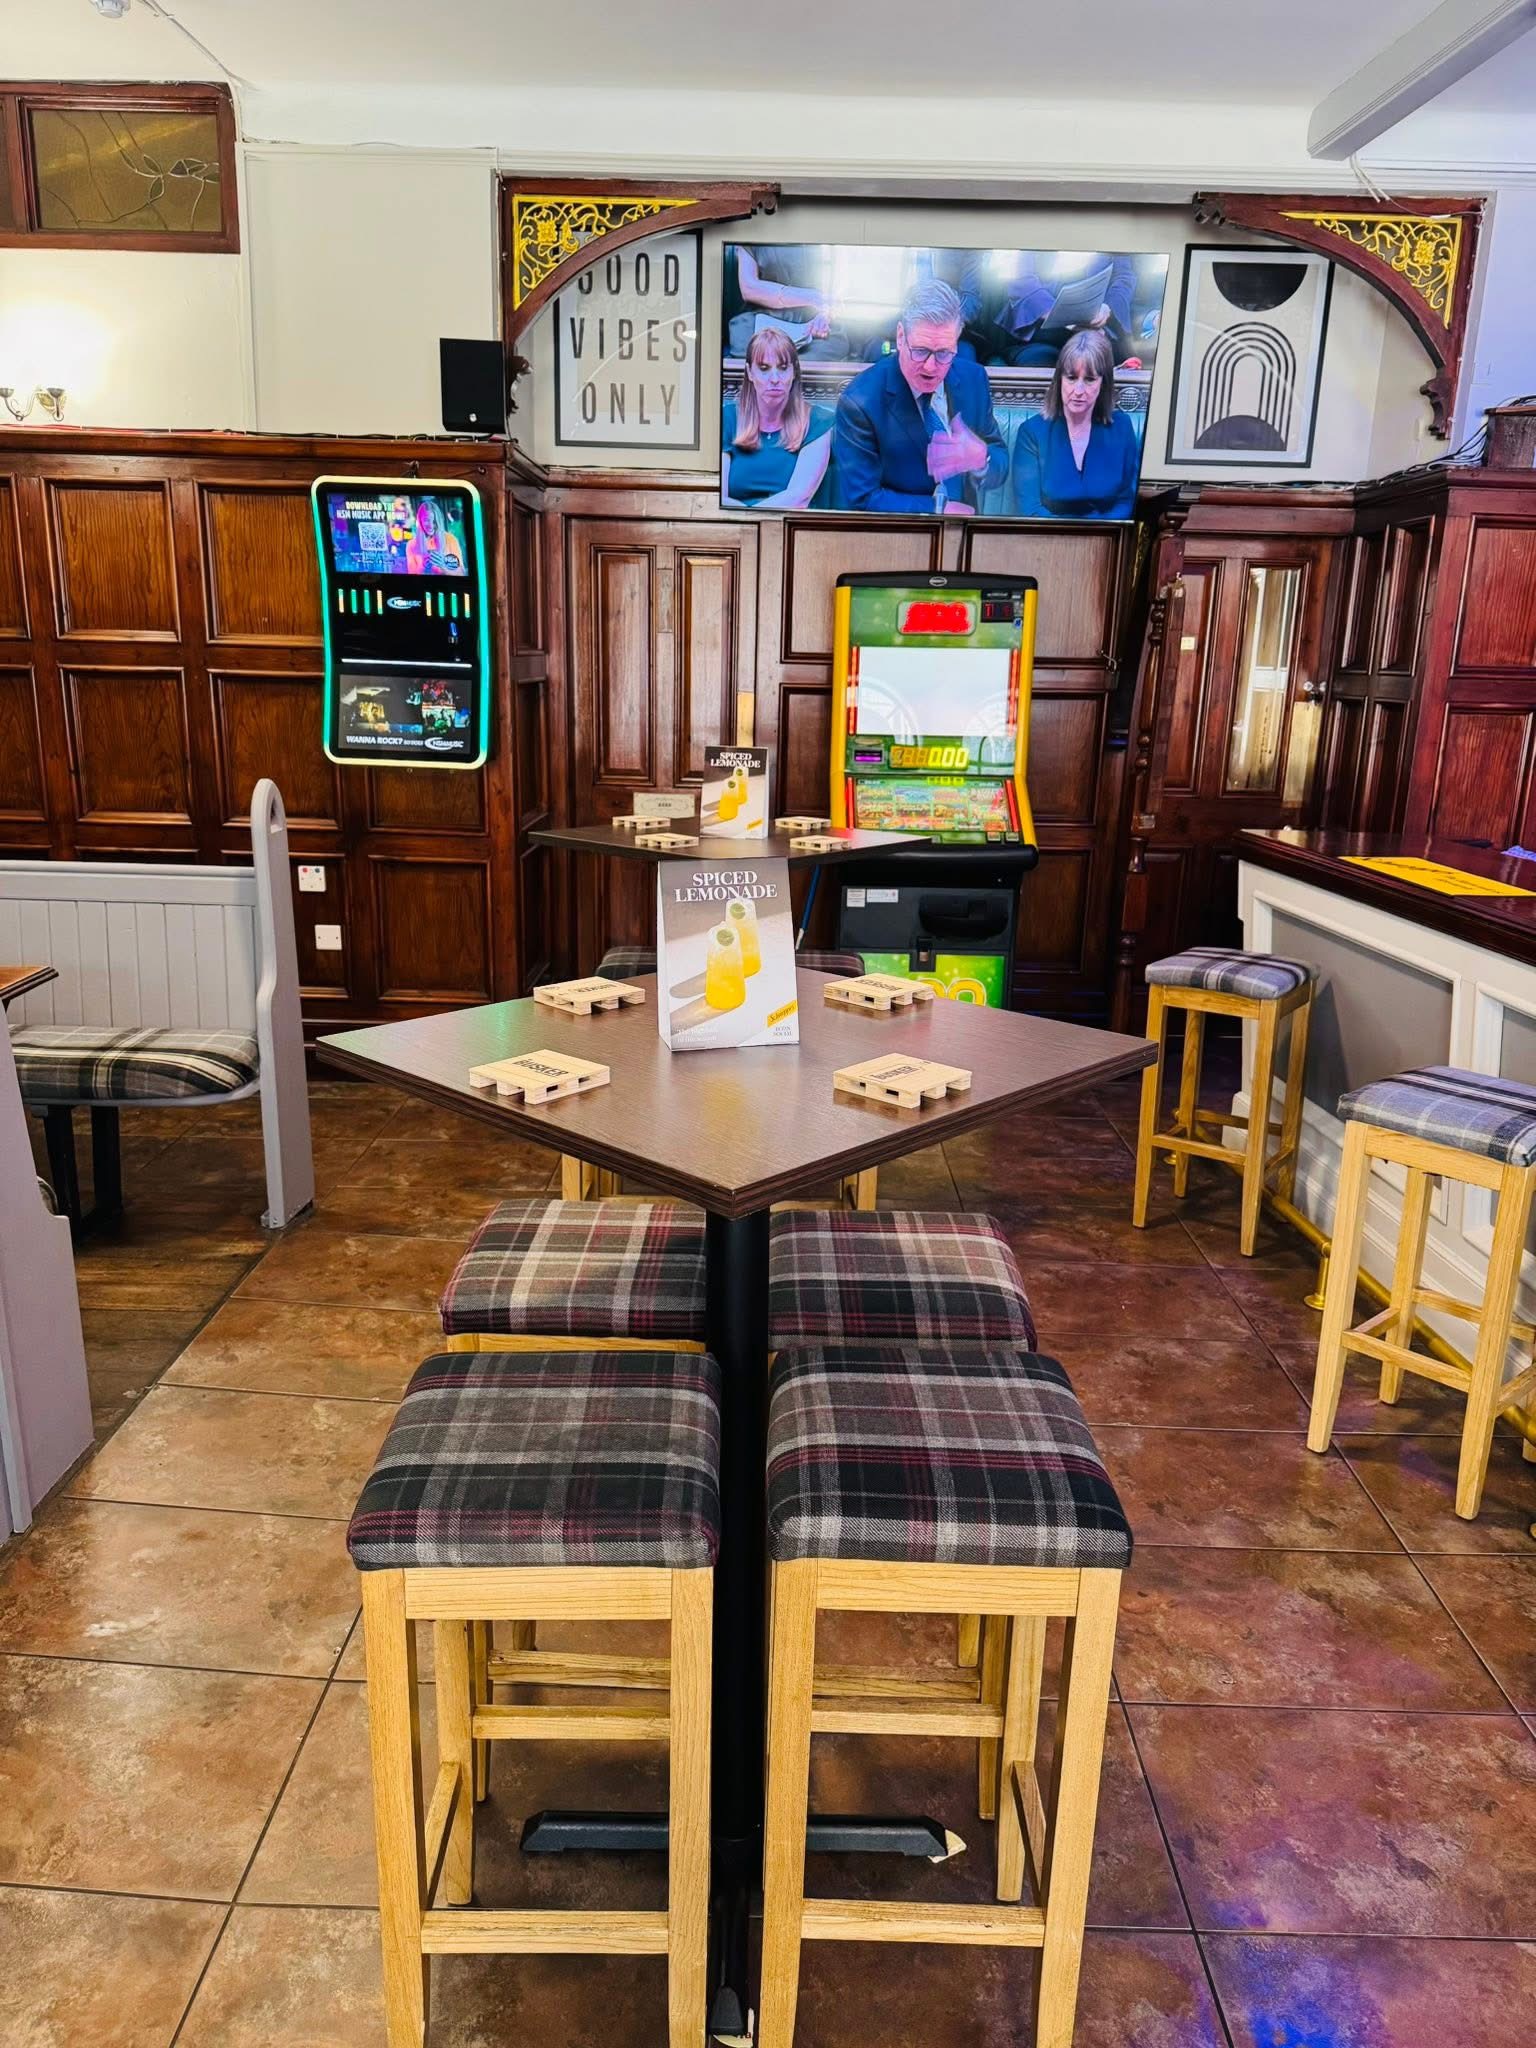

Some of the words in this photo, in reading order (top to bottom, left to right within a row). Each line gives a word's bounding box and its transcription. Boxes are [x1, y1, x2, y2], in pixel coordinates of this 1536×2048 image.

[570, 317, 687, 362] VIBES
[582, 382, 675, 425] ONLY
[345, 501, 383, 511] DOWNLOAD
[352, 510, 371, 519] MUSIC
[372, 511, 386, 520] APP
[346, 735, 376, 744] WANNA
[377, 736, 403, 745] ROCK?
[720, 752, 752, 760] SPICED
[710, 759, 761, 768] LEMONADE
[692, 870, 758, 887] SPICED
[674, 884, 778, 903] LEMONADE
[512, 1060, 569, 1077] BUSKER
